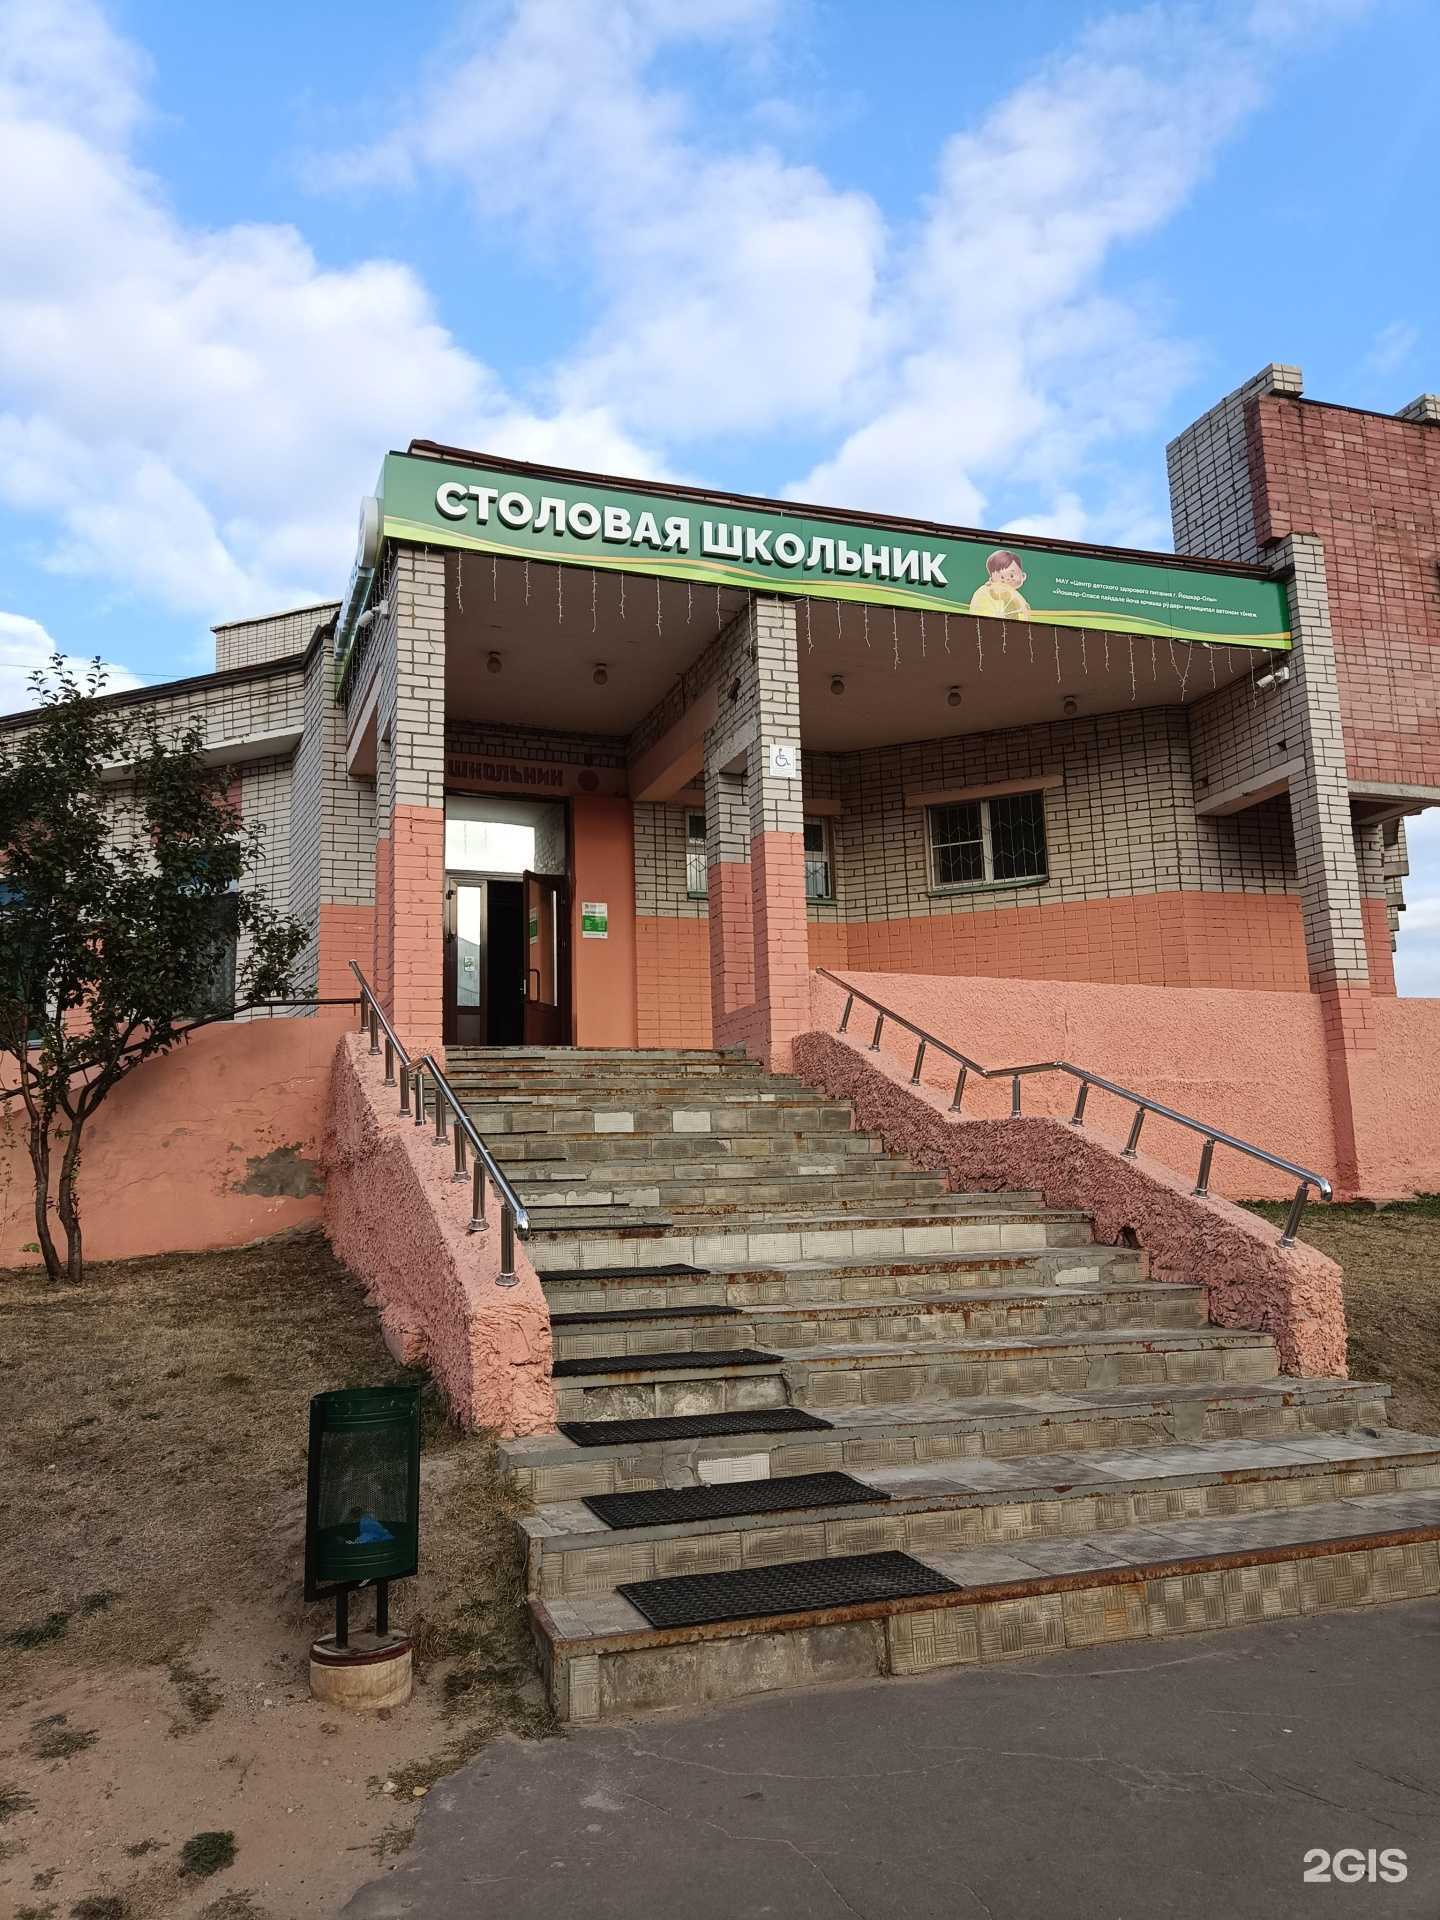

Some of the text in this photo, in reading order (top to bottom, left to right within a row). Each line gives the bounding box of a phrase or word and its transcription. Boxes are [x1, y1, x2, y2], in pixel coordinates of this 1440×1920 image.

[435, 481, 950, 587] СТОЛОВАЯ ШКОЛЬНИК
[1055, 577, 1069, 585] МАУ
[1070, 580, 1092, 589] «Центр
[1092, 583, 1119, 591] детского
[1119, 586, 1149, 595] здорового
[1149, 590, 1173, 598] питания
